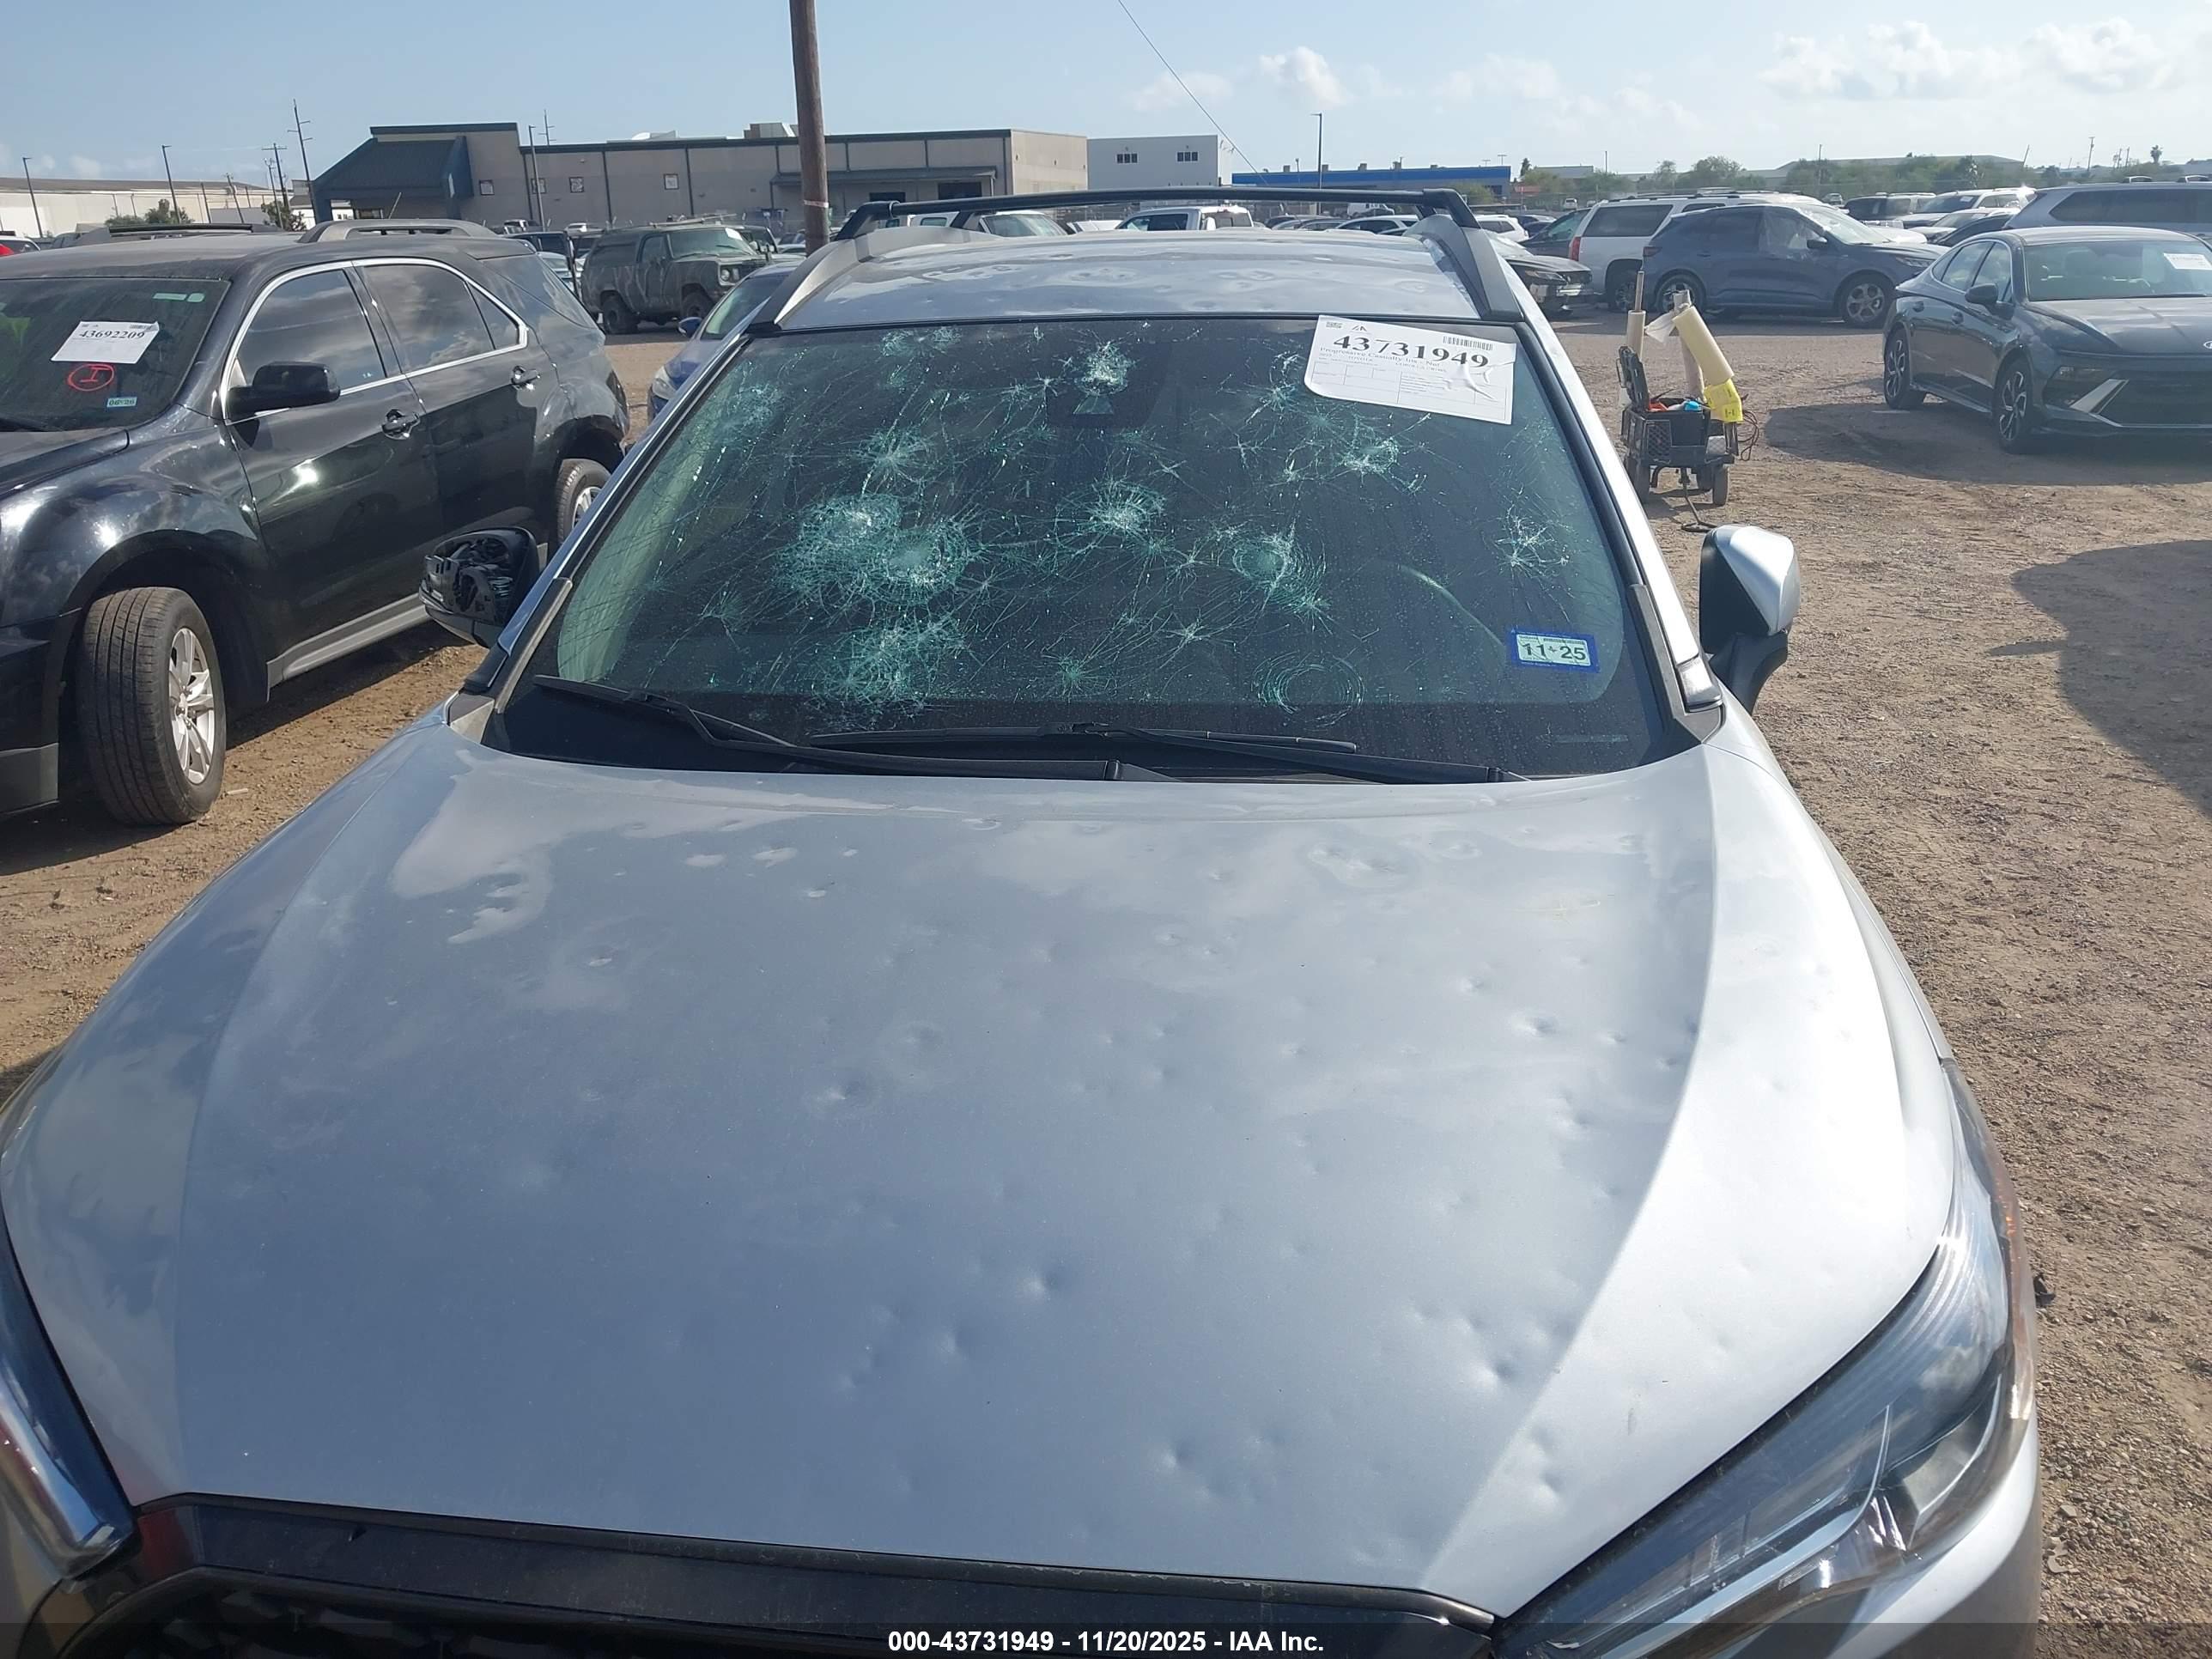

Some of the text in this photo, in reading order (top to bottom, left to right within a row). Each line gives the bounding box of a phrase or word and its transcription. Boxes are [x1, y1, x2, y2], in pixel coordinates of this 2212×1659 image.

[78, 330, 145, 339] 43692209
[1333, 335, 1489, 368] 43731949
[1522, 642, 1586, 660] 11 25
